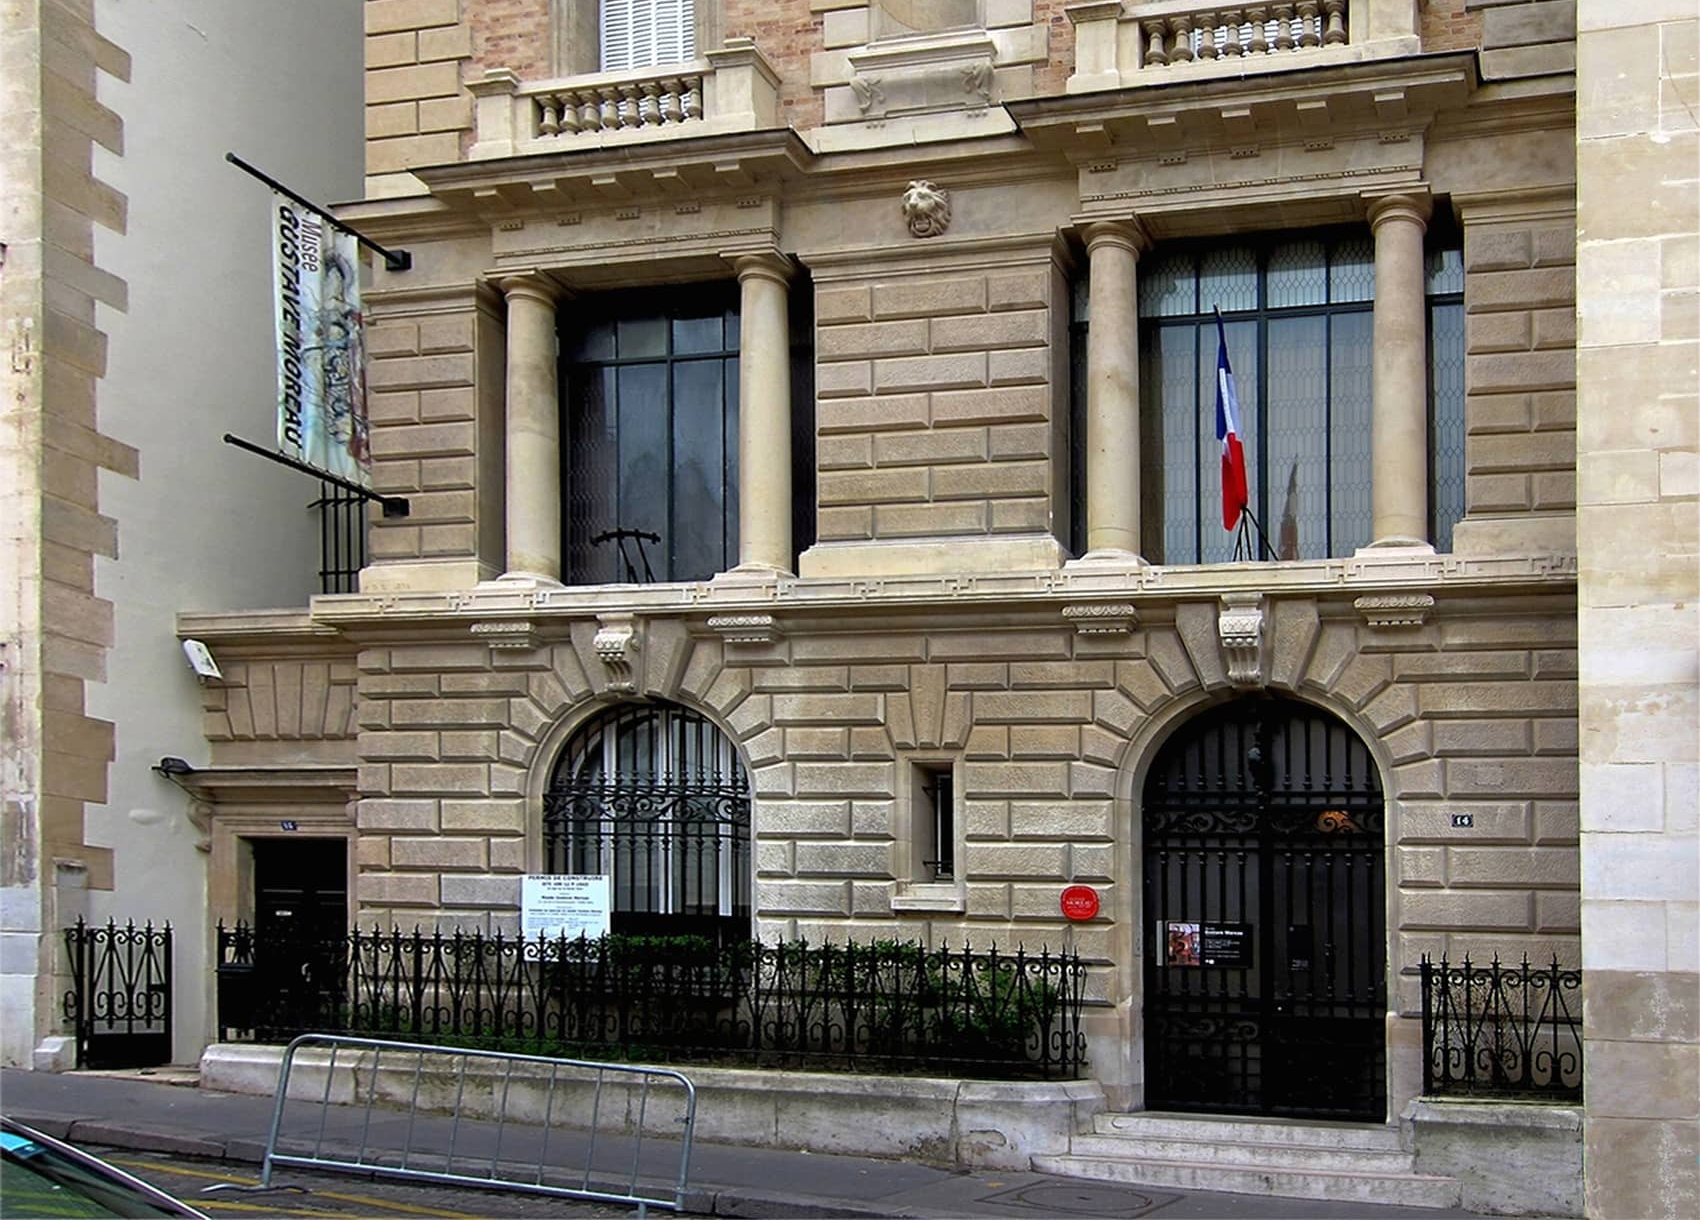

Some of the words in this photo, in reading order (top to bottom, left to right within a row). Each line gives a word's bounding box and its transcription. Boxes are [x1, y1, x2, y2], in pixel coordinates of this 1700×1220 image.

[279, 205, 301, 331] GUSTAVE
[283, 331, 302, 449] MOREAU
[1456, 816, 1470, 826] 14
